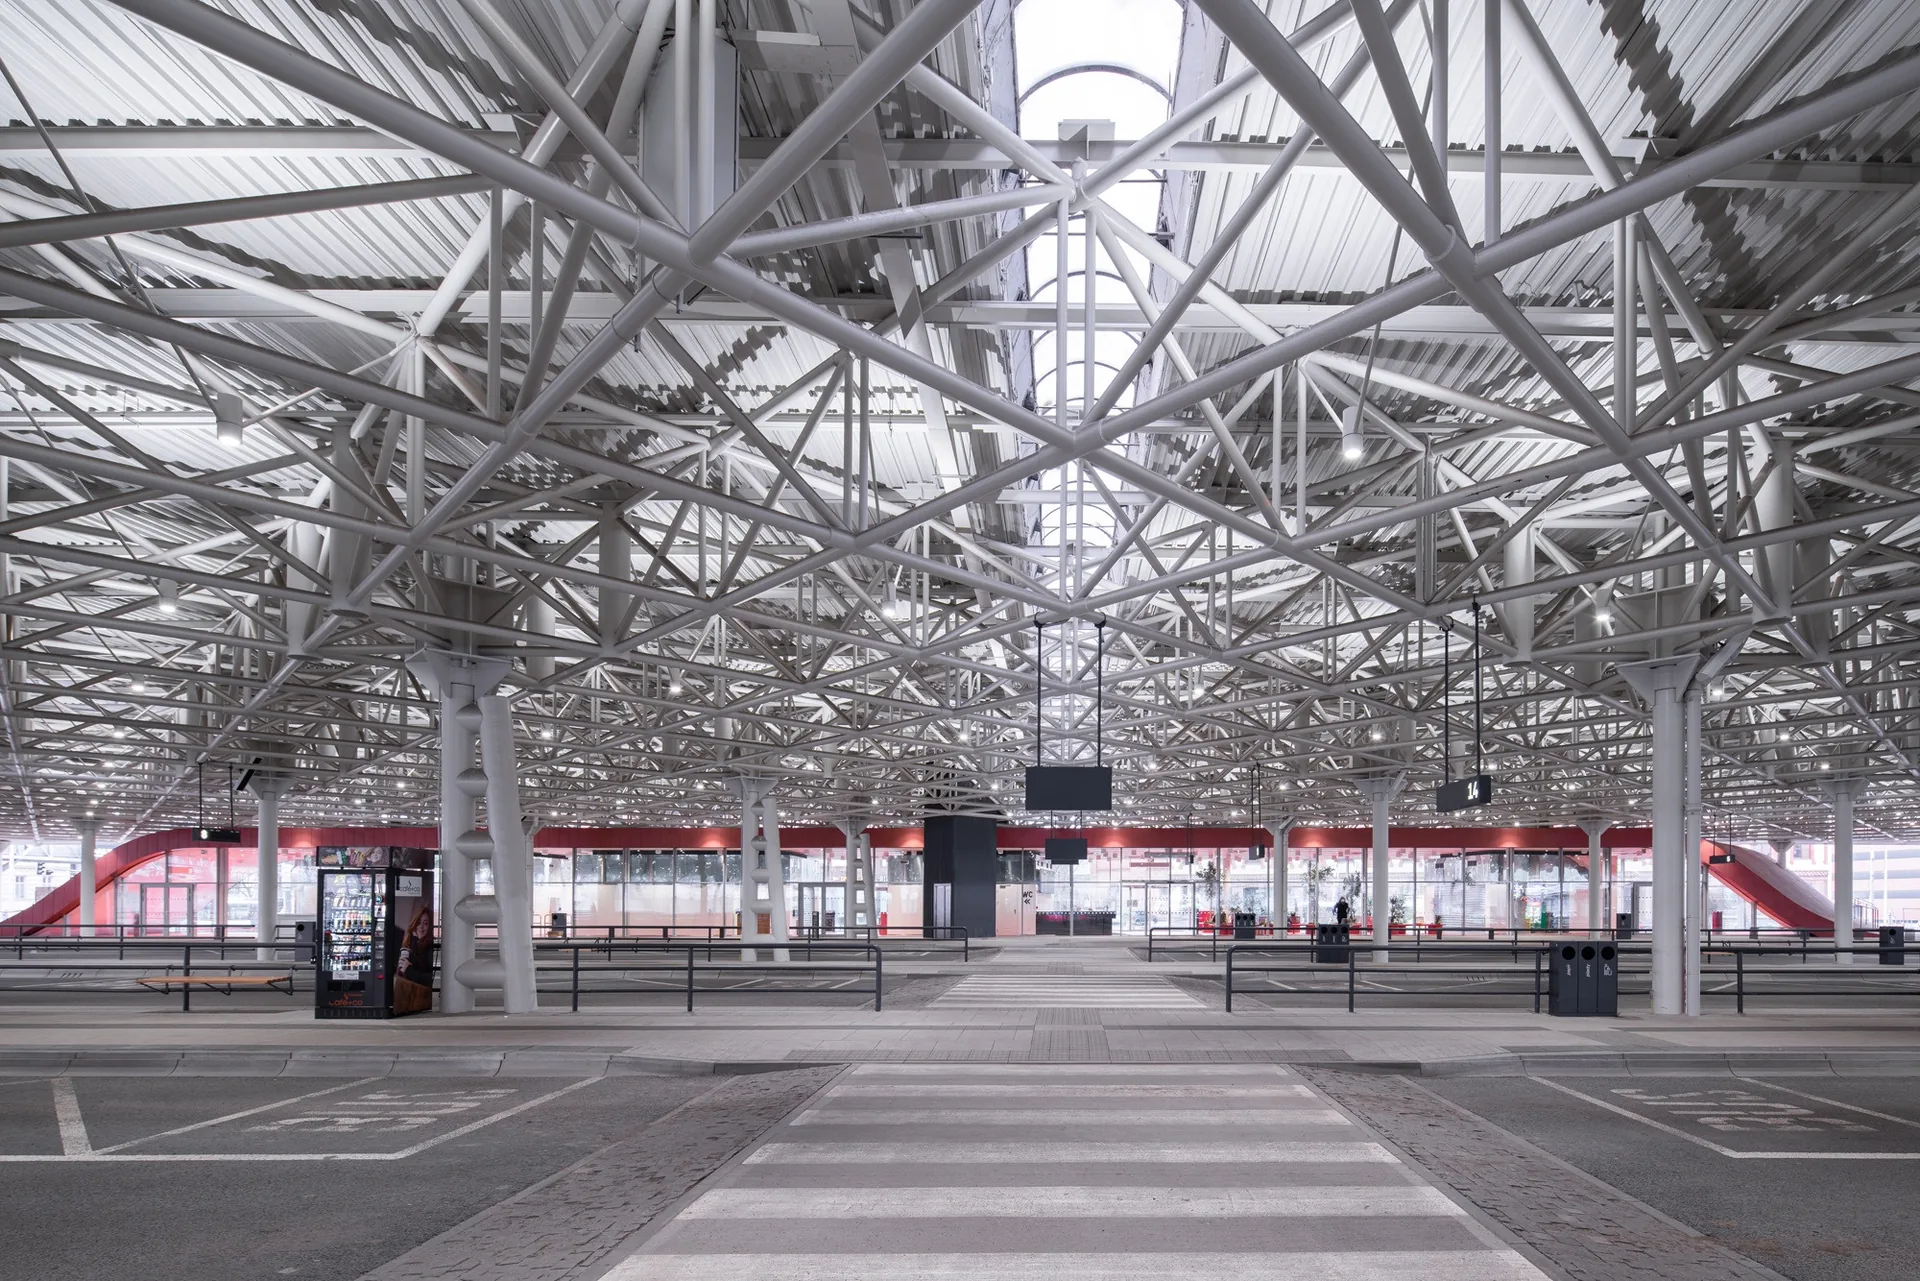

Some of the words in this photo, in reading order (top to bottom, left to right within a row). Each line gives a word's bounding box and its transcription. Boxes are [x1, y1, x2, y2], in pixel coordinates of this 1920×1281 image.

[1467, 781, 1479, 800] 14
[241, 1088, 520, 1132] BUS
[1610, 1088, 1880, 1132] BUS
